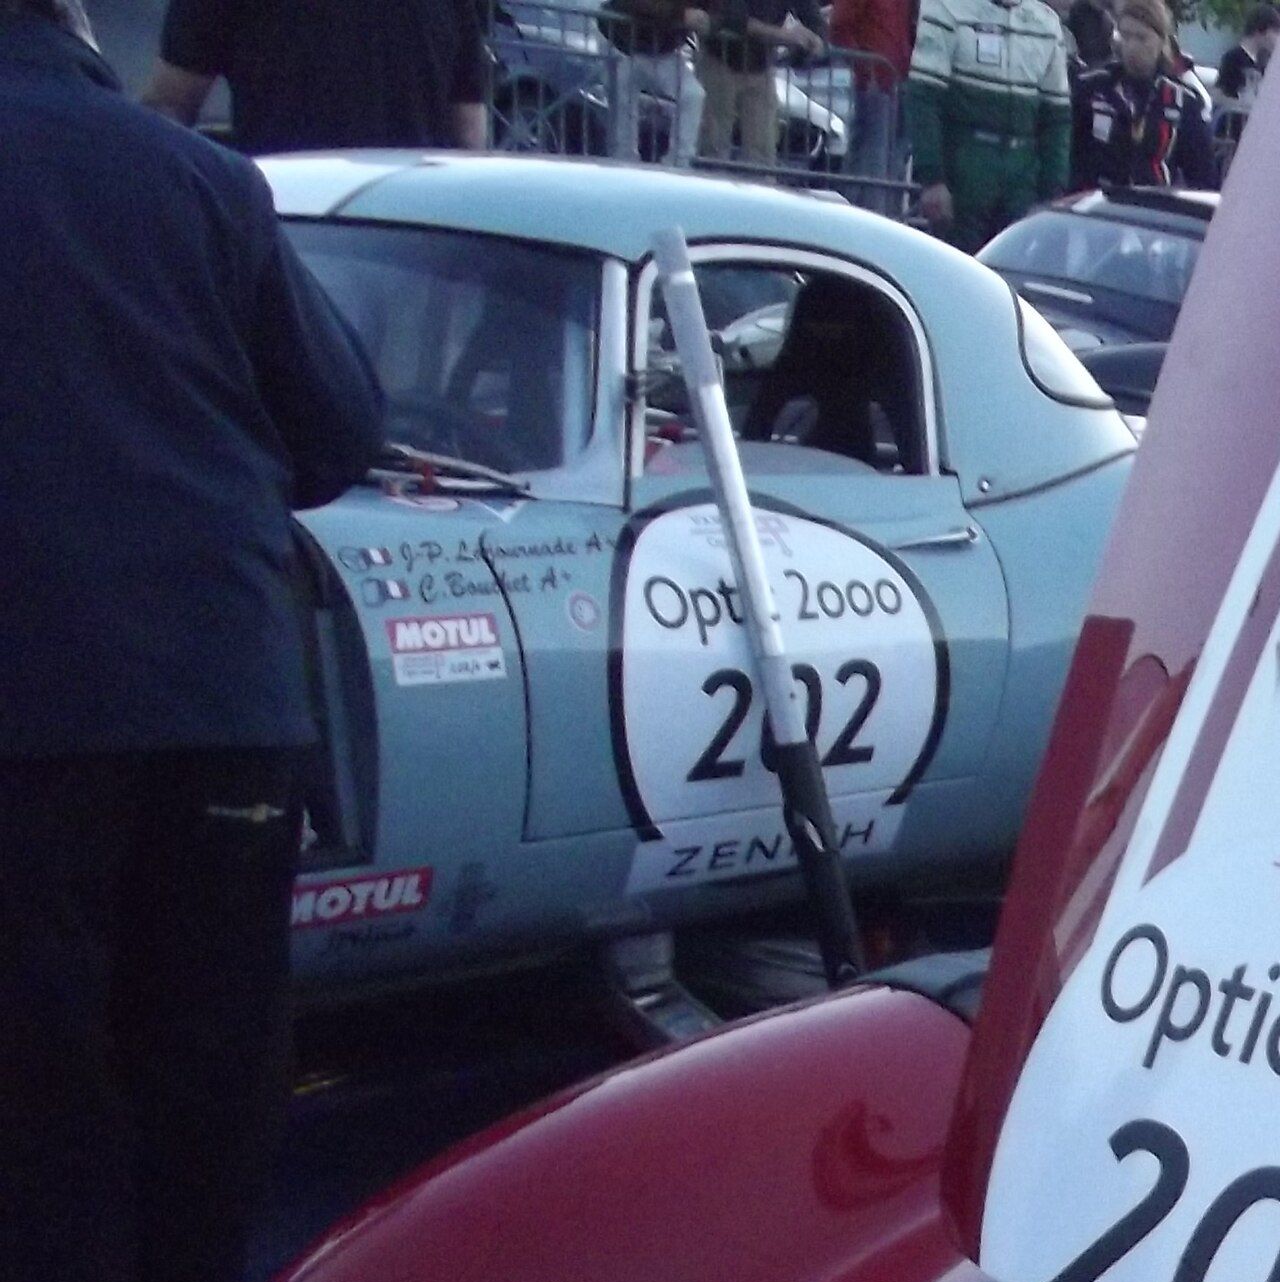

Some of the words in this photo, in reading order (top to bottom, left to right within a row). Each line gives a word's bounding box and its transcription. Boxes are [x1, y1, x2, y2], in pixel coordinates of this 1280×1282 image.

[394, 616, 497, 650] MOTUL
[643, 575, 781, 646] Opt
[783, 568, 902, 621] 2000
[665, 820, 876, 878] ZENH
